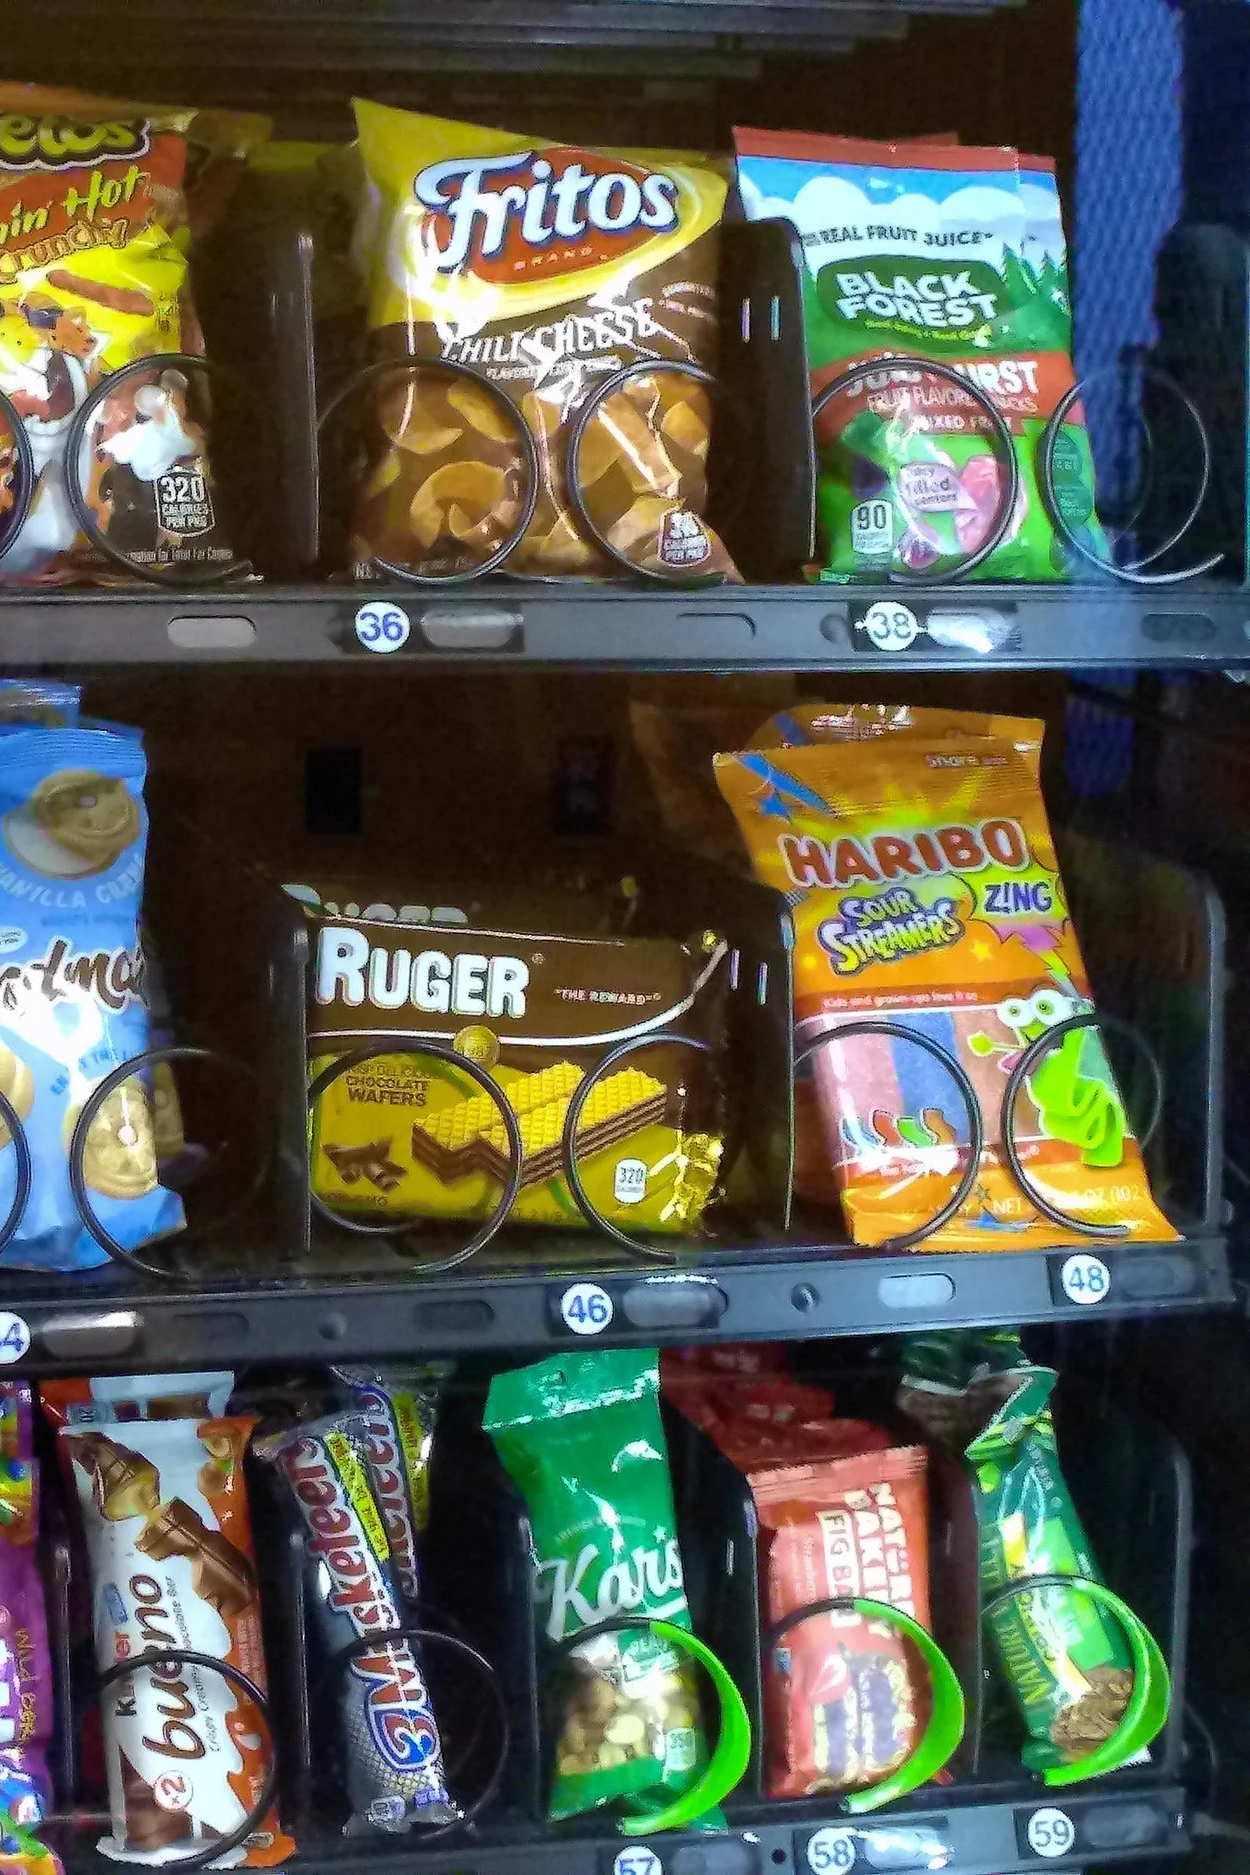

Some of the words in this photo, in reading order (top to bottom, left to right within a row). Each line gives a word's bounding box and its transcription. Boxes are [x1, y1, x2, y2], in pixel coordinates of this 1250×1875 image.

[63, 165, 148, 220] Hot
[413, 149, 679, 274] Fritos
[866, 224, 918, 242] FRUIT
[835, 270, 981, 302] BLACK
[836, 292, 999, 328] FOREST
[160, 476, 205, 503] 320
[856, 504, 888, 531] 90
[359, 611, 403, 642] 36
[871, 611, 913, 641] 38
[780, 819, 1027, 888] HARIBO
[842, 890, 922, 929] SOUR
[820, 902, 963, 974] STREAMERS
[316, 925, 531, 1020] RUGER
[344, 1074, 432, 1092] CHOCOLATE
[347, 1087, 428, 1107] WAFERS
[618, 1165, 647, 1186] 320
[1067, 1265, 1106, 1294] 48
[567, 1294, 610, 1326] 46
[823, 1514, 851, 1557] FIG
[843, 1488, 893, 1641] BAKEY
[831, 1565, 856, 1618] BA
[128, 1573, 207, 1760] bueno
[382, 1708, 440, 1768] 3
[1033, 1819, 1072, 1848] 59
[618, 1857, 652, 1875] 57
[812, 1837, 850, 1868] 58
